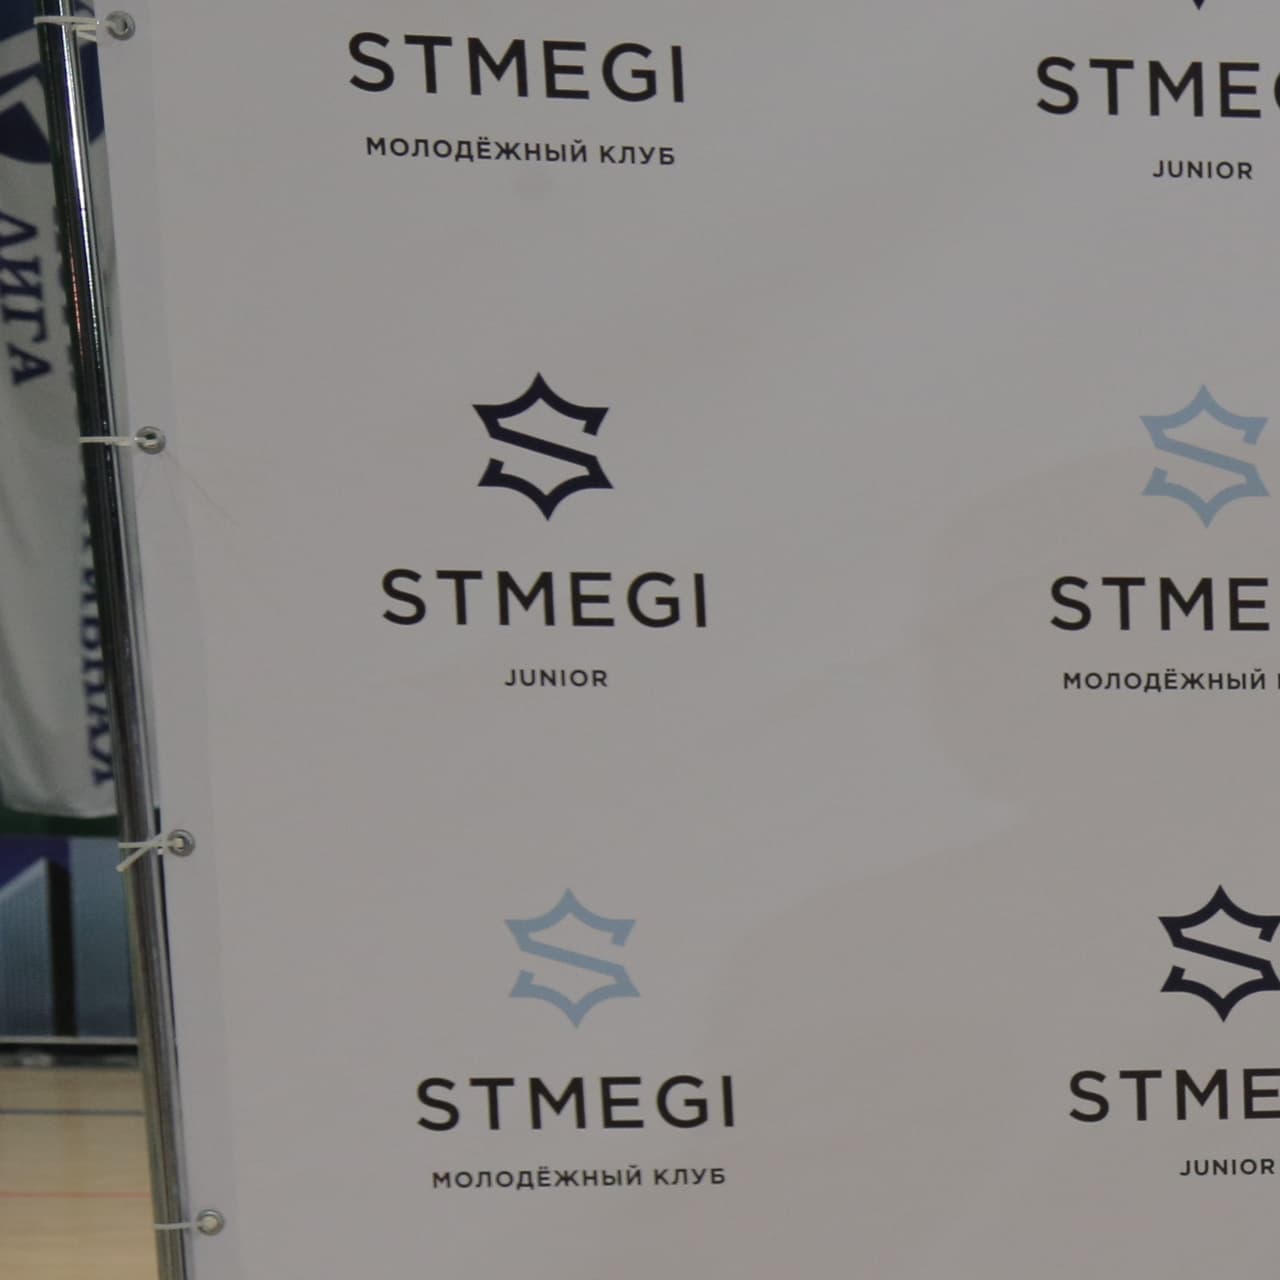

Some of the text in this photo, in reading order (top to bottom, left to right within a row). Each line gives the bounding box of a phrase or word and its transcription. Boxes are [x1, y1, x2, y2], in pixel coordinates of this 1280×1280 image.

[348, 31, 685, 103] STMEGI
[366, 136, 675, 166] МОЛОДЁЖНЫЙ КЛУБ
[1152, 159, 1253, 180] JUNIOR
[381, 568, 707, 629] STMEGI
[504, 668, 608, 688] JUNIOR
[1063, 668, 1266, 693] МОЛОДЁЖНЫЙ
[417, 1074, 735, 1132] STMEGI
[432, 1164, 726, 1191] МОЛОДЁЖНЫЙ КЛУБ
[1179, 1158, 1275, 1177] JUNIOR
